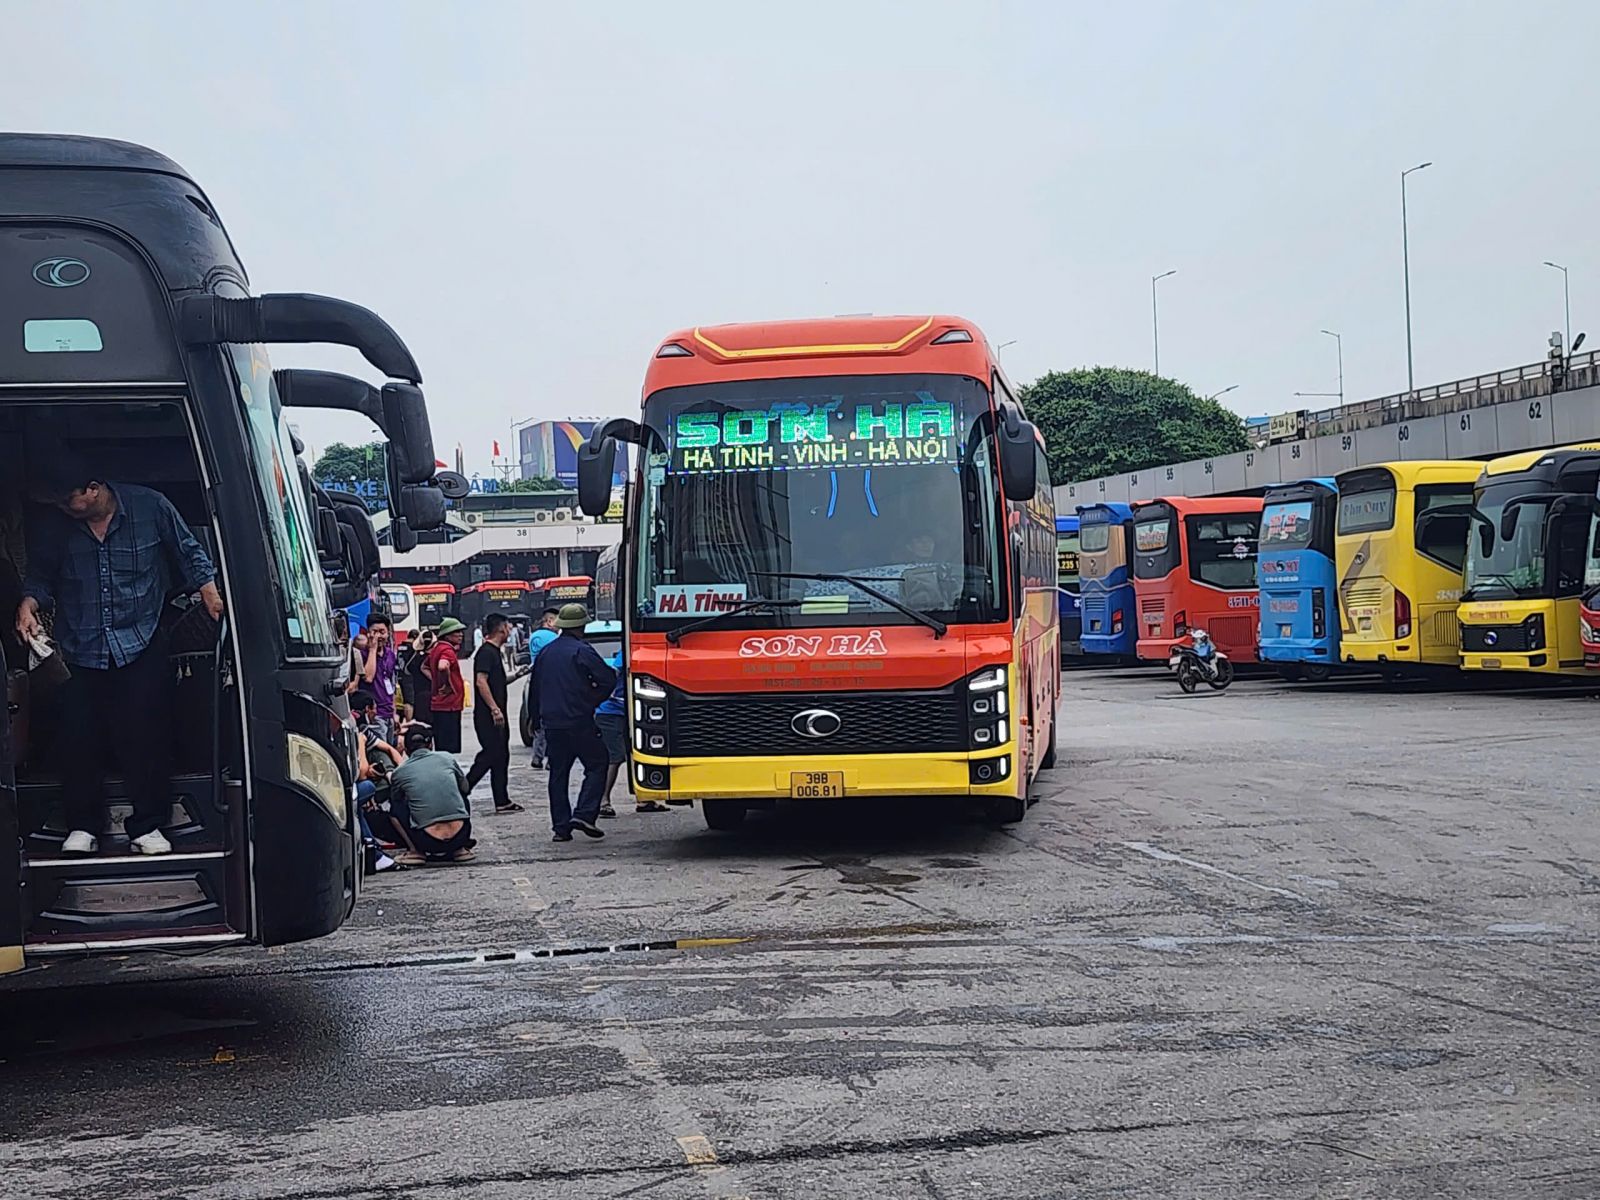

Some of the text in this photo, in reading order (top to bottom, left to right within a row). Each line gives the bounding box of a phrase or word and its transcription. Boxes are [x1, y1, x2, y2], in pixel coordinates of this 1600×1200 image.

[856, 391, 955, 440] HÀ
[1528, 402, 1542, 419] 62
[1460, 414, 1472, 431] 61
[1398, 426, 1409, 441] 60
[1341, 436, 1351, 451] 59
[684, 448, 714, 469] HÀ
[793, 442, 847, 465] VINH
[868, 438, 901, 461] HÀ
[906, 436, 948, 464] NỘI
[1292, 445, 1301, 459] 58
[1246, 454, 1254, 467] 57
[1166, 468, 1174, 480] 55
[1204, 462, 1213, 474] 56
[1099, 481, 1106, 492] 53
[1131, 475, 1138, 487] 54
[353, 481, 378, 496] XE
[1069, 486, 1075, 497] 52
[576, 527, 585, 535] 39
[659, 588, 743, 613] HÀ TĨNH
[739, 630, 888, 658] SƠN HÀ
[806, 773, 828, 784] 38B
[797, 785, 836, 797] 006.81
